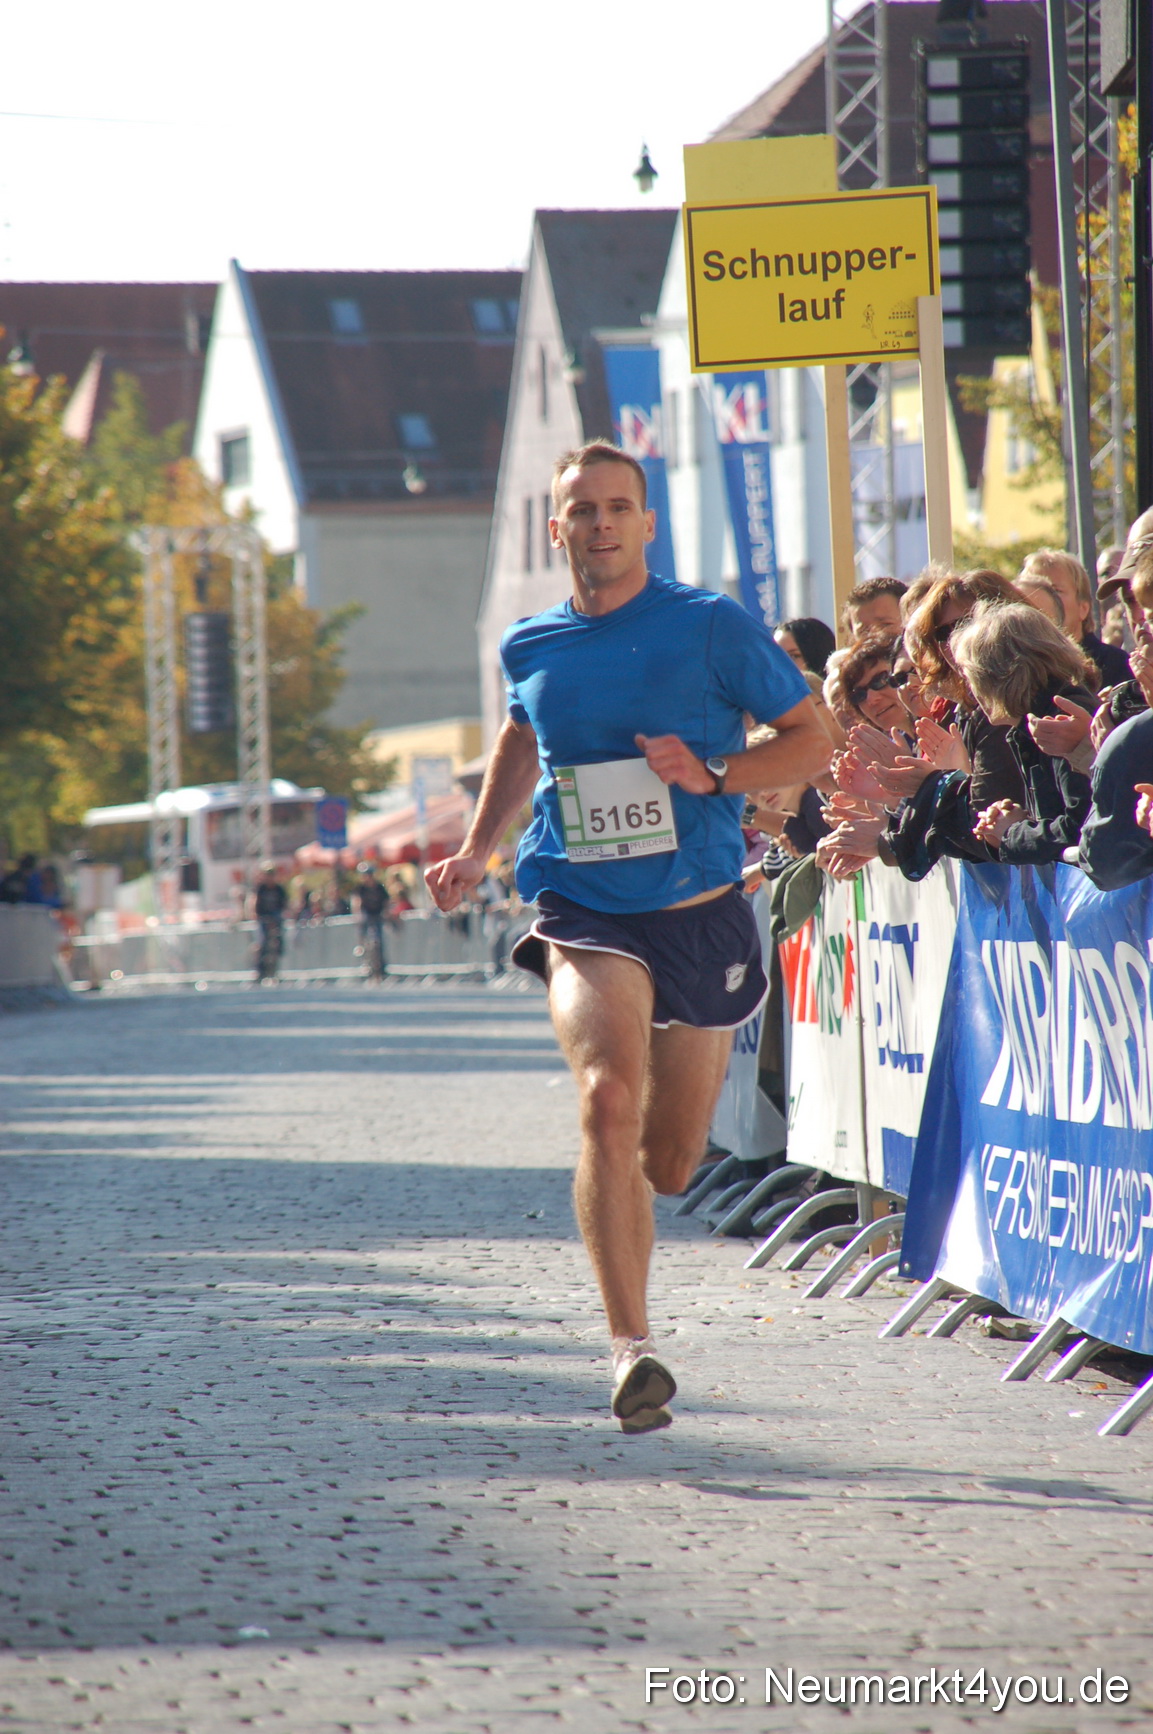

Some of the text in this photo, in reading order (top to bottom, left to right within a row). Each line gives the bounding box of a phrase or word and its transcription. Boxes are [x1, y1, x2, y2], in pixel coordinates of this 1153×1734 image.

[703, 245, 917, 282] Schnupper-
[778, 288, 846, 324] lauf
[589, 800, 663, 834] 5165
[629, 835, 674, 850] PFLEIDERER
